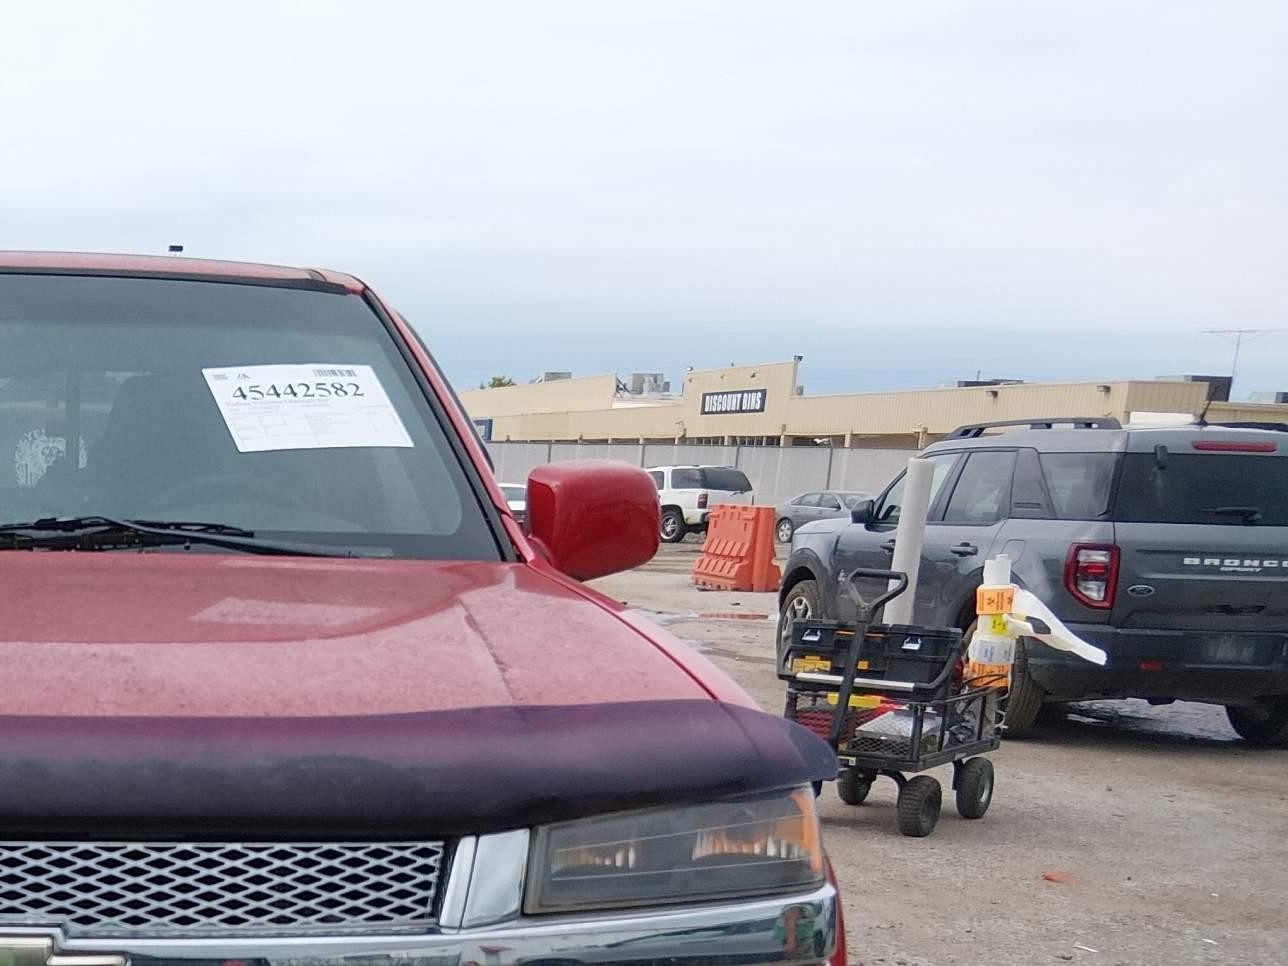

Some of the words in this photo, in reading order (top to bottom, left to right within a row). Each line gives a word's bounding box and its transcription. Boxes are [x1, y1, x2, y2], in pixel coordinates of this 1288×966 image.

[232, 382, 365, 400] 45442582
[704, 393, 742, 412] DISCOUNT
[742, 391, 762, 410] BINS
